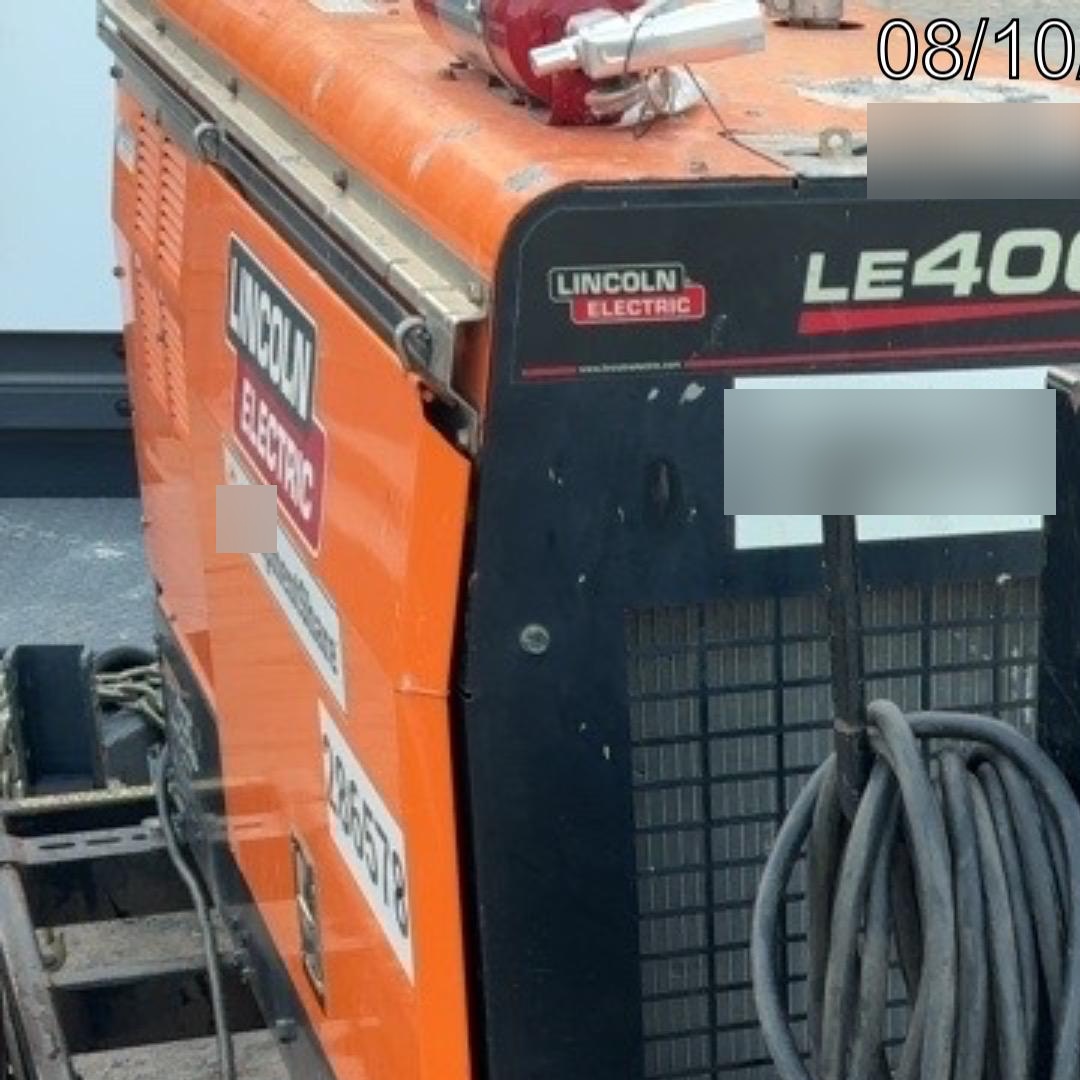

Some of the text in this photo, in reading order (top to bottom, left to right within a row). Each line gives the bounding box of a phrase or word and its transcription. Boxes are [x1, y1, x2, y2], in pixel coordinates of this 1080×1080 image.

[556, 269, 677, 296] LINCOLN
[586, 298, 691, 319] ELECTRIC
[230, 255, 312, 423] LINCOLN
[241, 375, 314, 521] ELECTRIC
